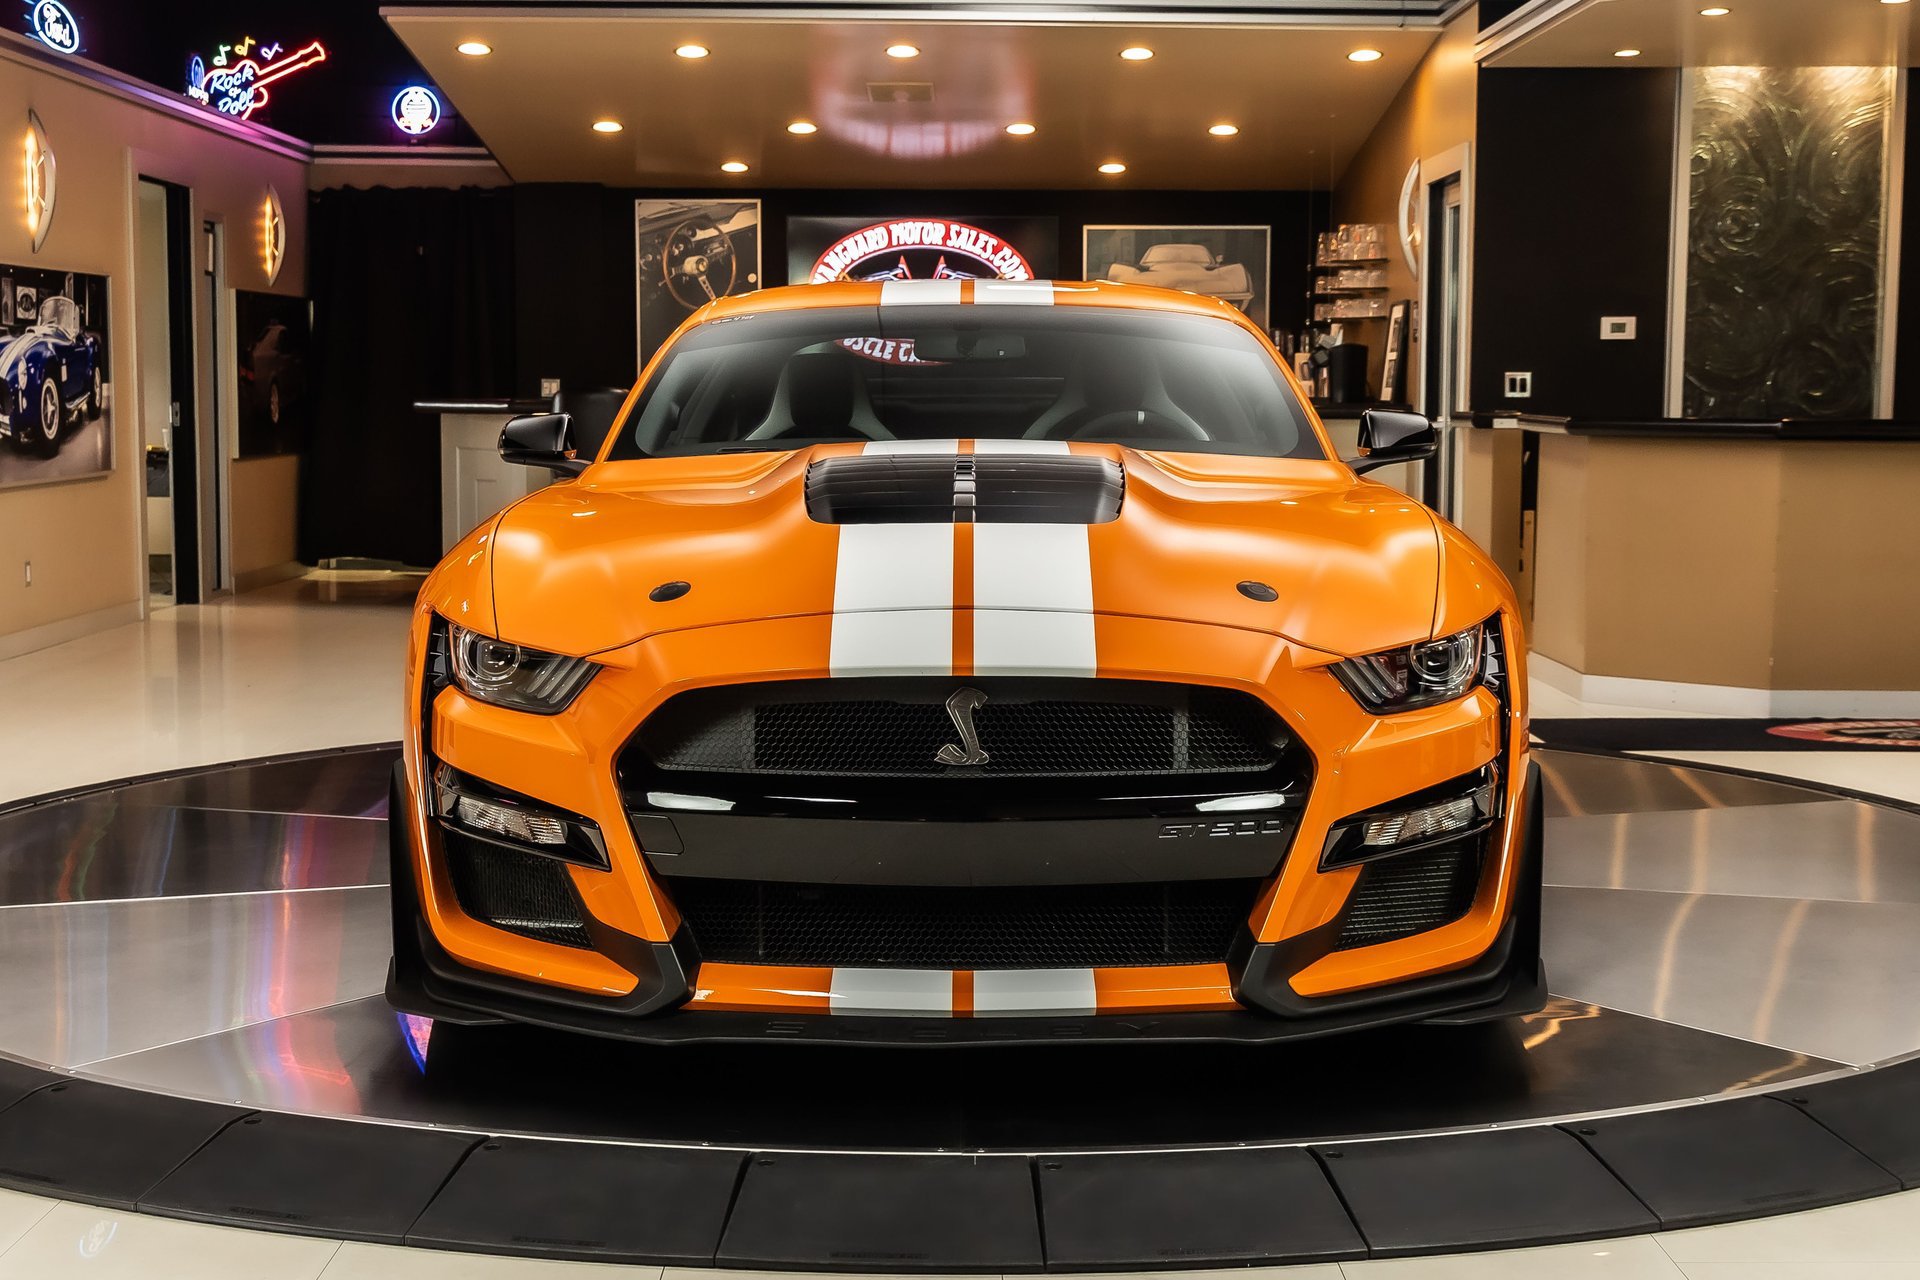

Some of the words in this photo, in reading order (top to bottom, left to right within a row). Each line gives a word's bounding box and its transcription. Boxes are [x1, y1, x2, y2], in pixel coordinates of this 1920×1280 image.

[210, 63, 254, 94] Rock
[889, 221, 946, 246] MOTOR
[1158, 820, 1285, 839] GT500
